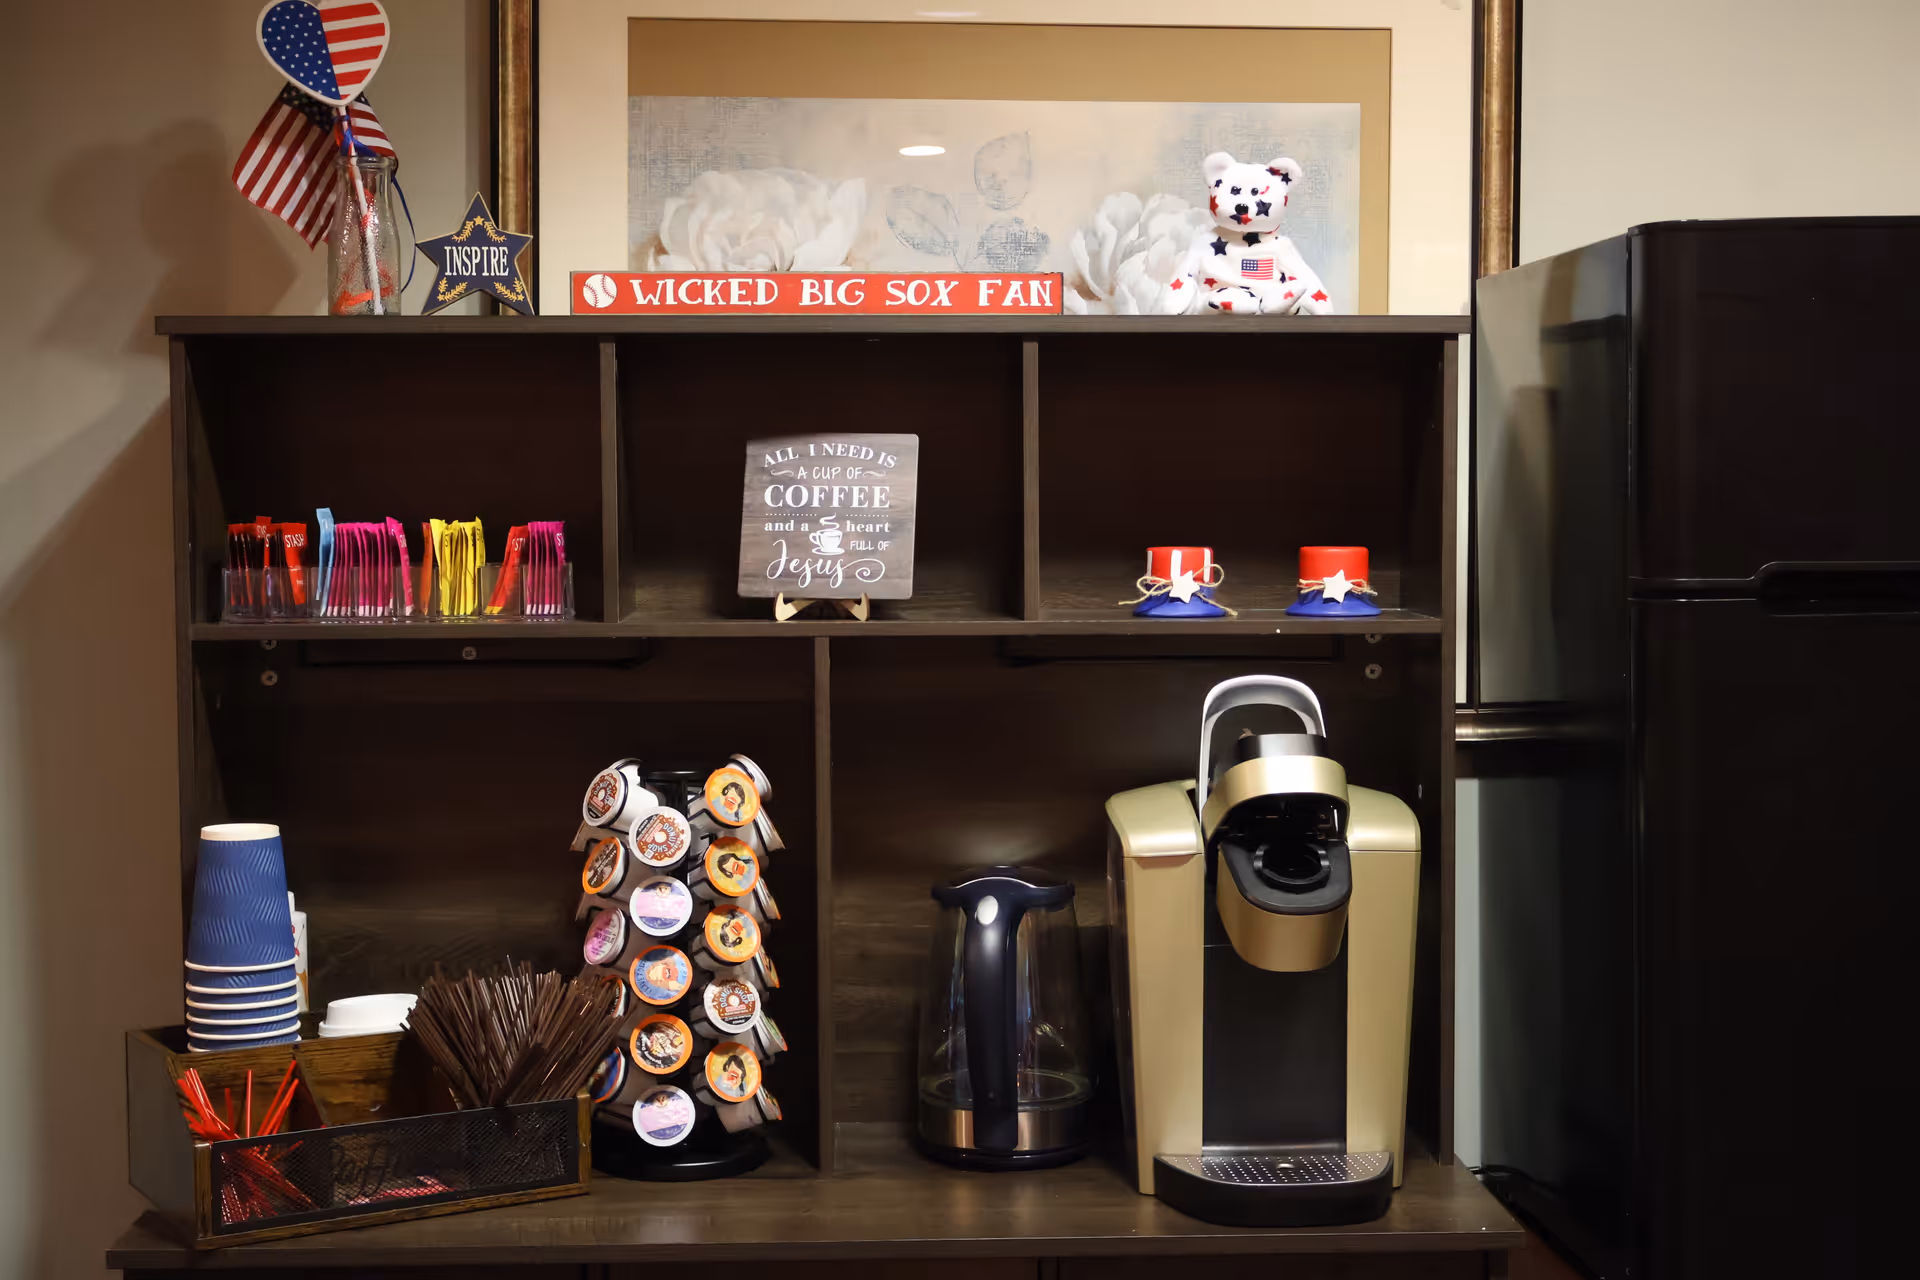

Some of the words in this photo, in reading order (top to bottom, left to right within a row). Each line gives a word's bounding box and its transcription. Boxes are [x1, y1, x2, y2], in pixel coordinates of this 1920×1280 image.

[444, 246, 509, 276] INSPIRE
[629, 278, 779, 306] WICKED
[798, 278, 865, 306] BIG
[885, 279, 959, 306] SOX
[978, 279, 1053, 306] FAN
[764, 447, 799, 467] ALL
[808, 443, 816, 456] I
[822, 443, 874, 460] NEED
[877, 452, 897, 468] IS
[797, 466, 808, 480] A
[812, 466, 841, 480] CUP
[847, 466, 863, 480] OF
[764, 484, 890, 508] COFFEE
[764, 520, 794, 532] and
[801, 522, 809, 532] a
[846, 520, 890, 533] heart
[284, 533, 304, 548] STASH
[850, 540, 874, 551] FULL
[877, 540, 890, 551] OF
[767, 539, 850, 588] Jesus
[662, 823, 677, 848] DONUT
